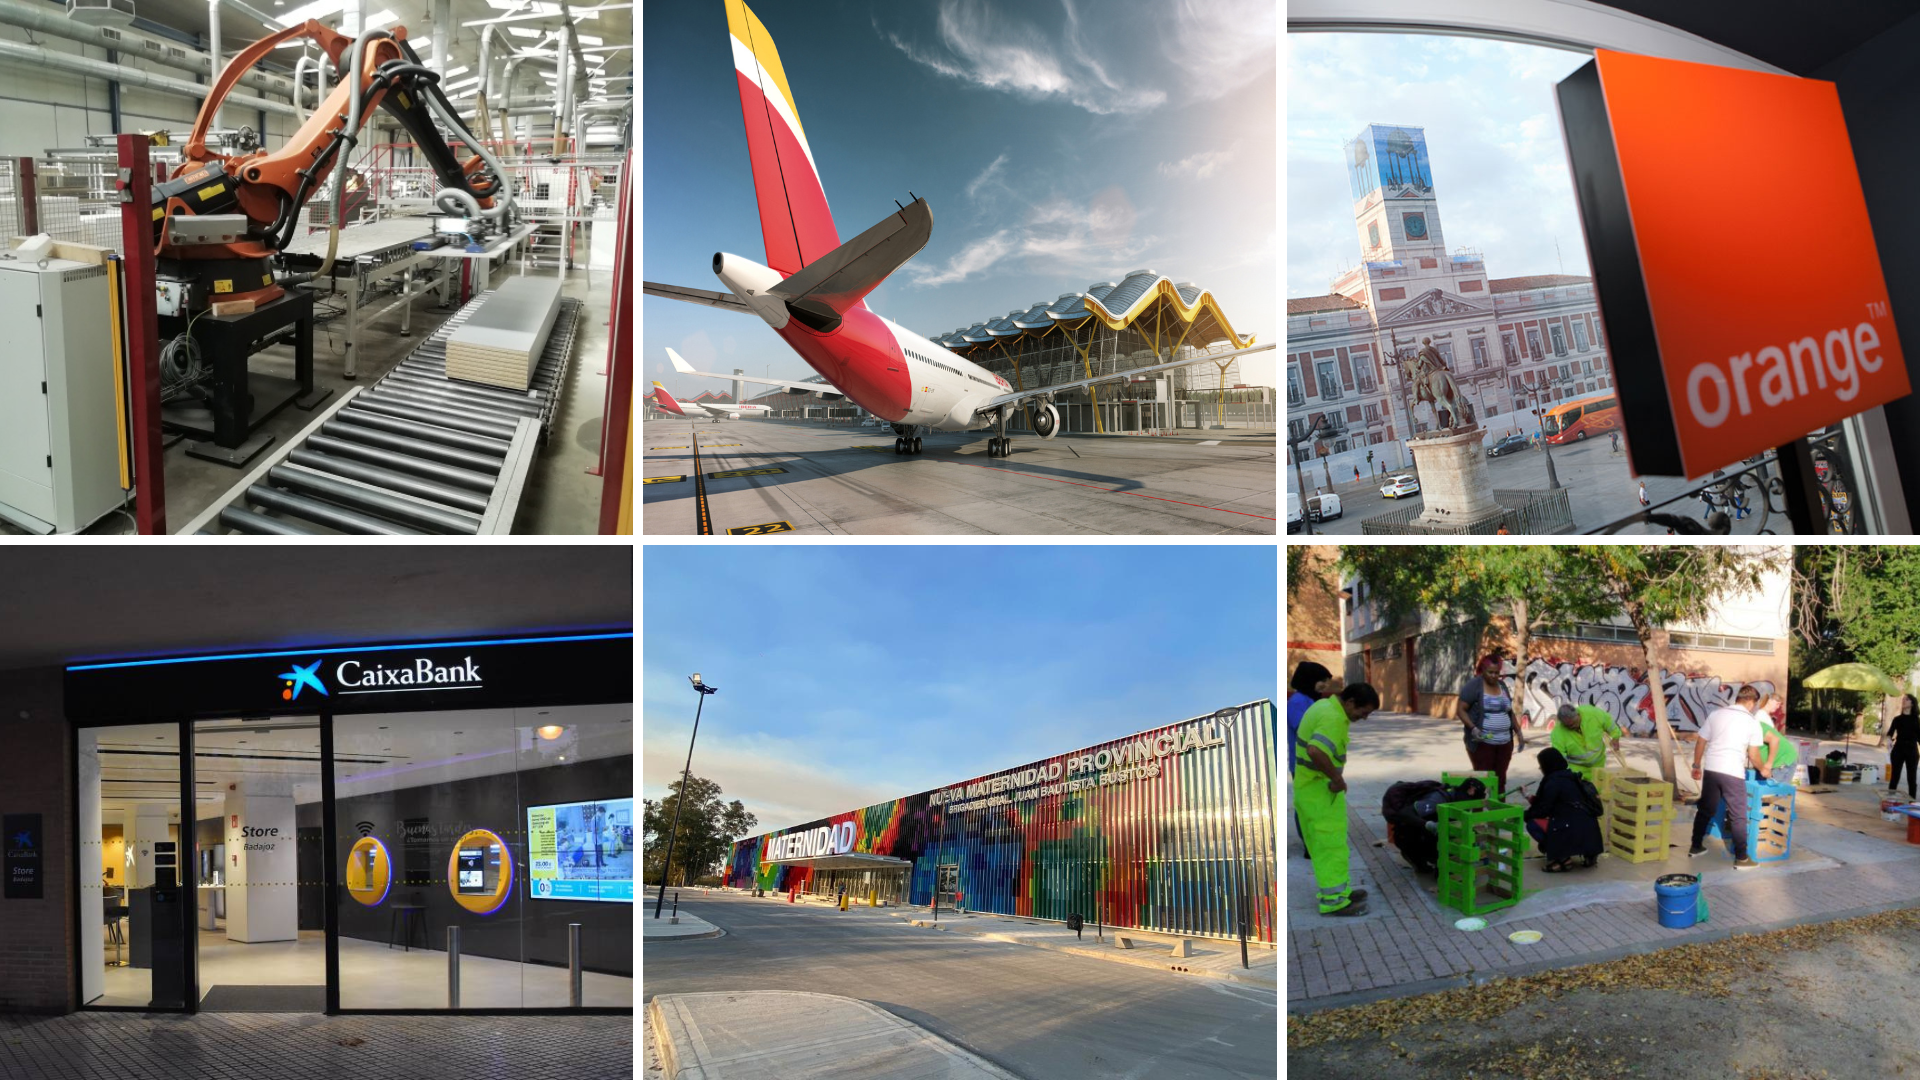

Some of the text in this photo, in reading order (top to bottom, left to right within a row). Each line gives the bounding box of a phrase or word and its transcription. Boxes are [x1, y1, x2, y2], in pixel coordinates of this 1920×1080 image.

[1866, 301, 1887, 319] TM
[1687, 322, 1884, 428] orange
[336, 656, 482, 687] CaixaBank
[929, 723, 1224, 807] NUEVA MATERNIDAD PROVINCIAL
[1014, 788, 1039, 802] JUAN
[1041, 777, 1097, 797] BAUTISTA
[1099, 763, 1161, 787] BUSTOS
[241, 826, 279, 837] Store
[243, 843, 276, 852] Badajoz
[766, 821, 856, 861] MATERNIDAD
